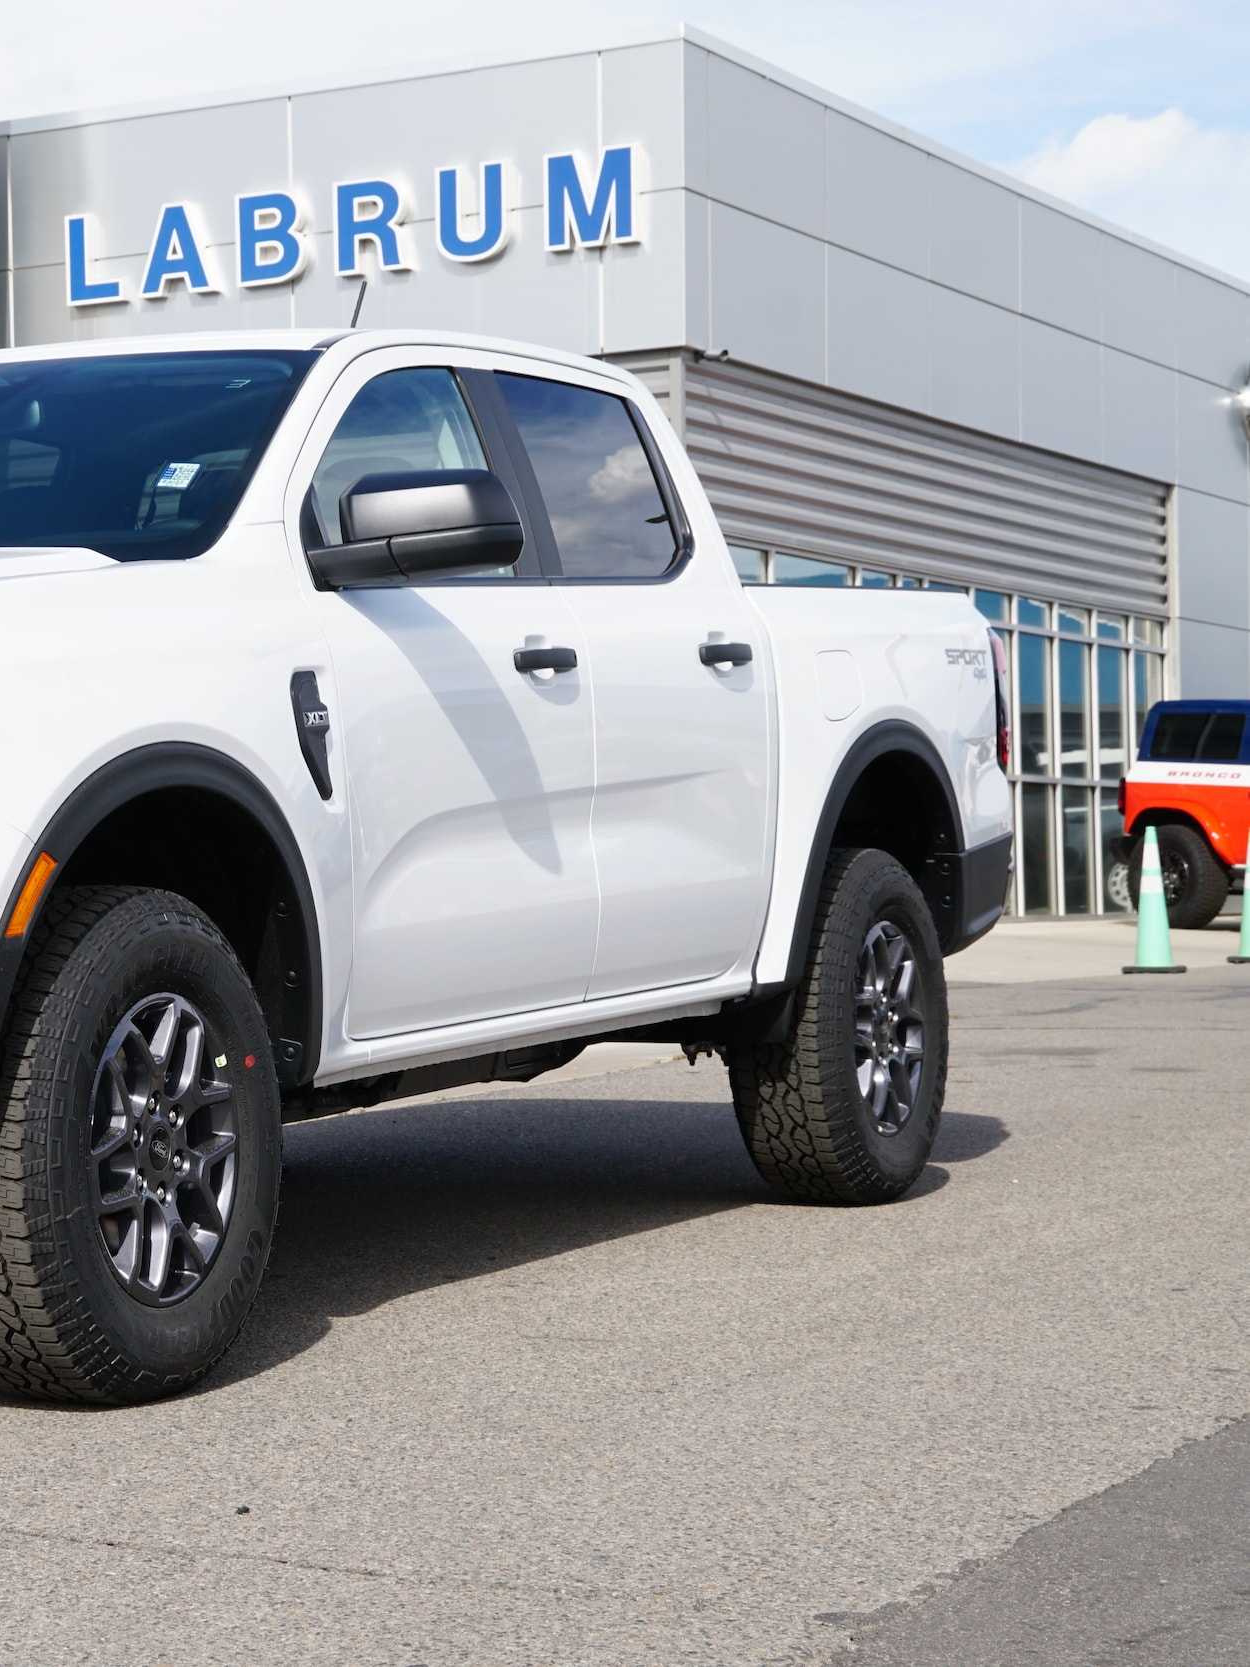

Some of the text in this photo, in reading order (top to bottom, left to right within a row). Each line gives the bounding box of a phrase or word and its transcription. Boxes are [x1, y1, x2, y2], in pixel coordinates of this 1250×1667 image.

[65, 144, 639, 306] LABRUM
[944, 648, 988, 666] SPORT
[303, 711, 328, 726] XLT
[1167, 770, 1242, 779] BRONCO
